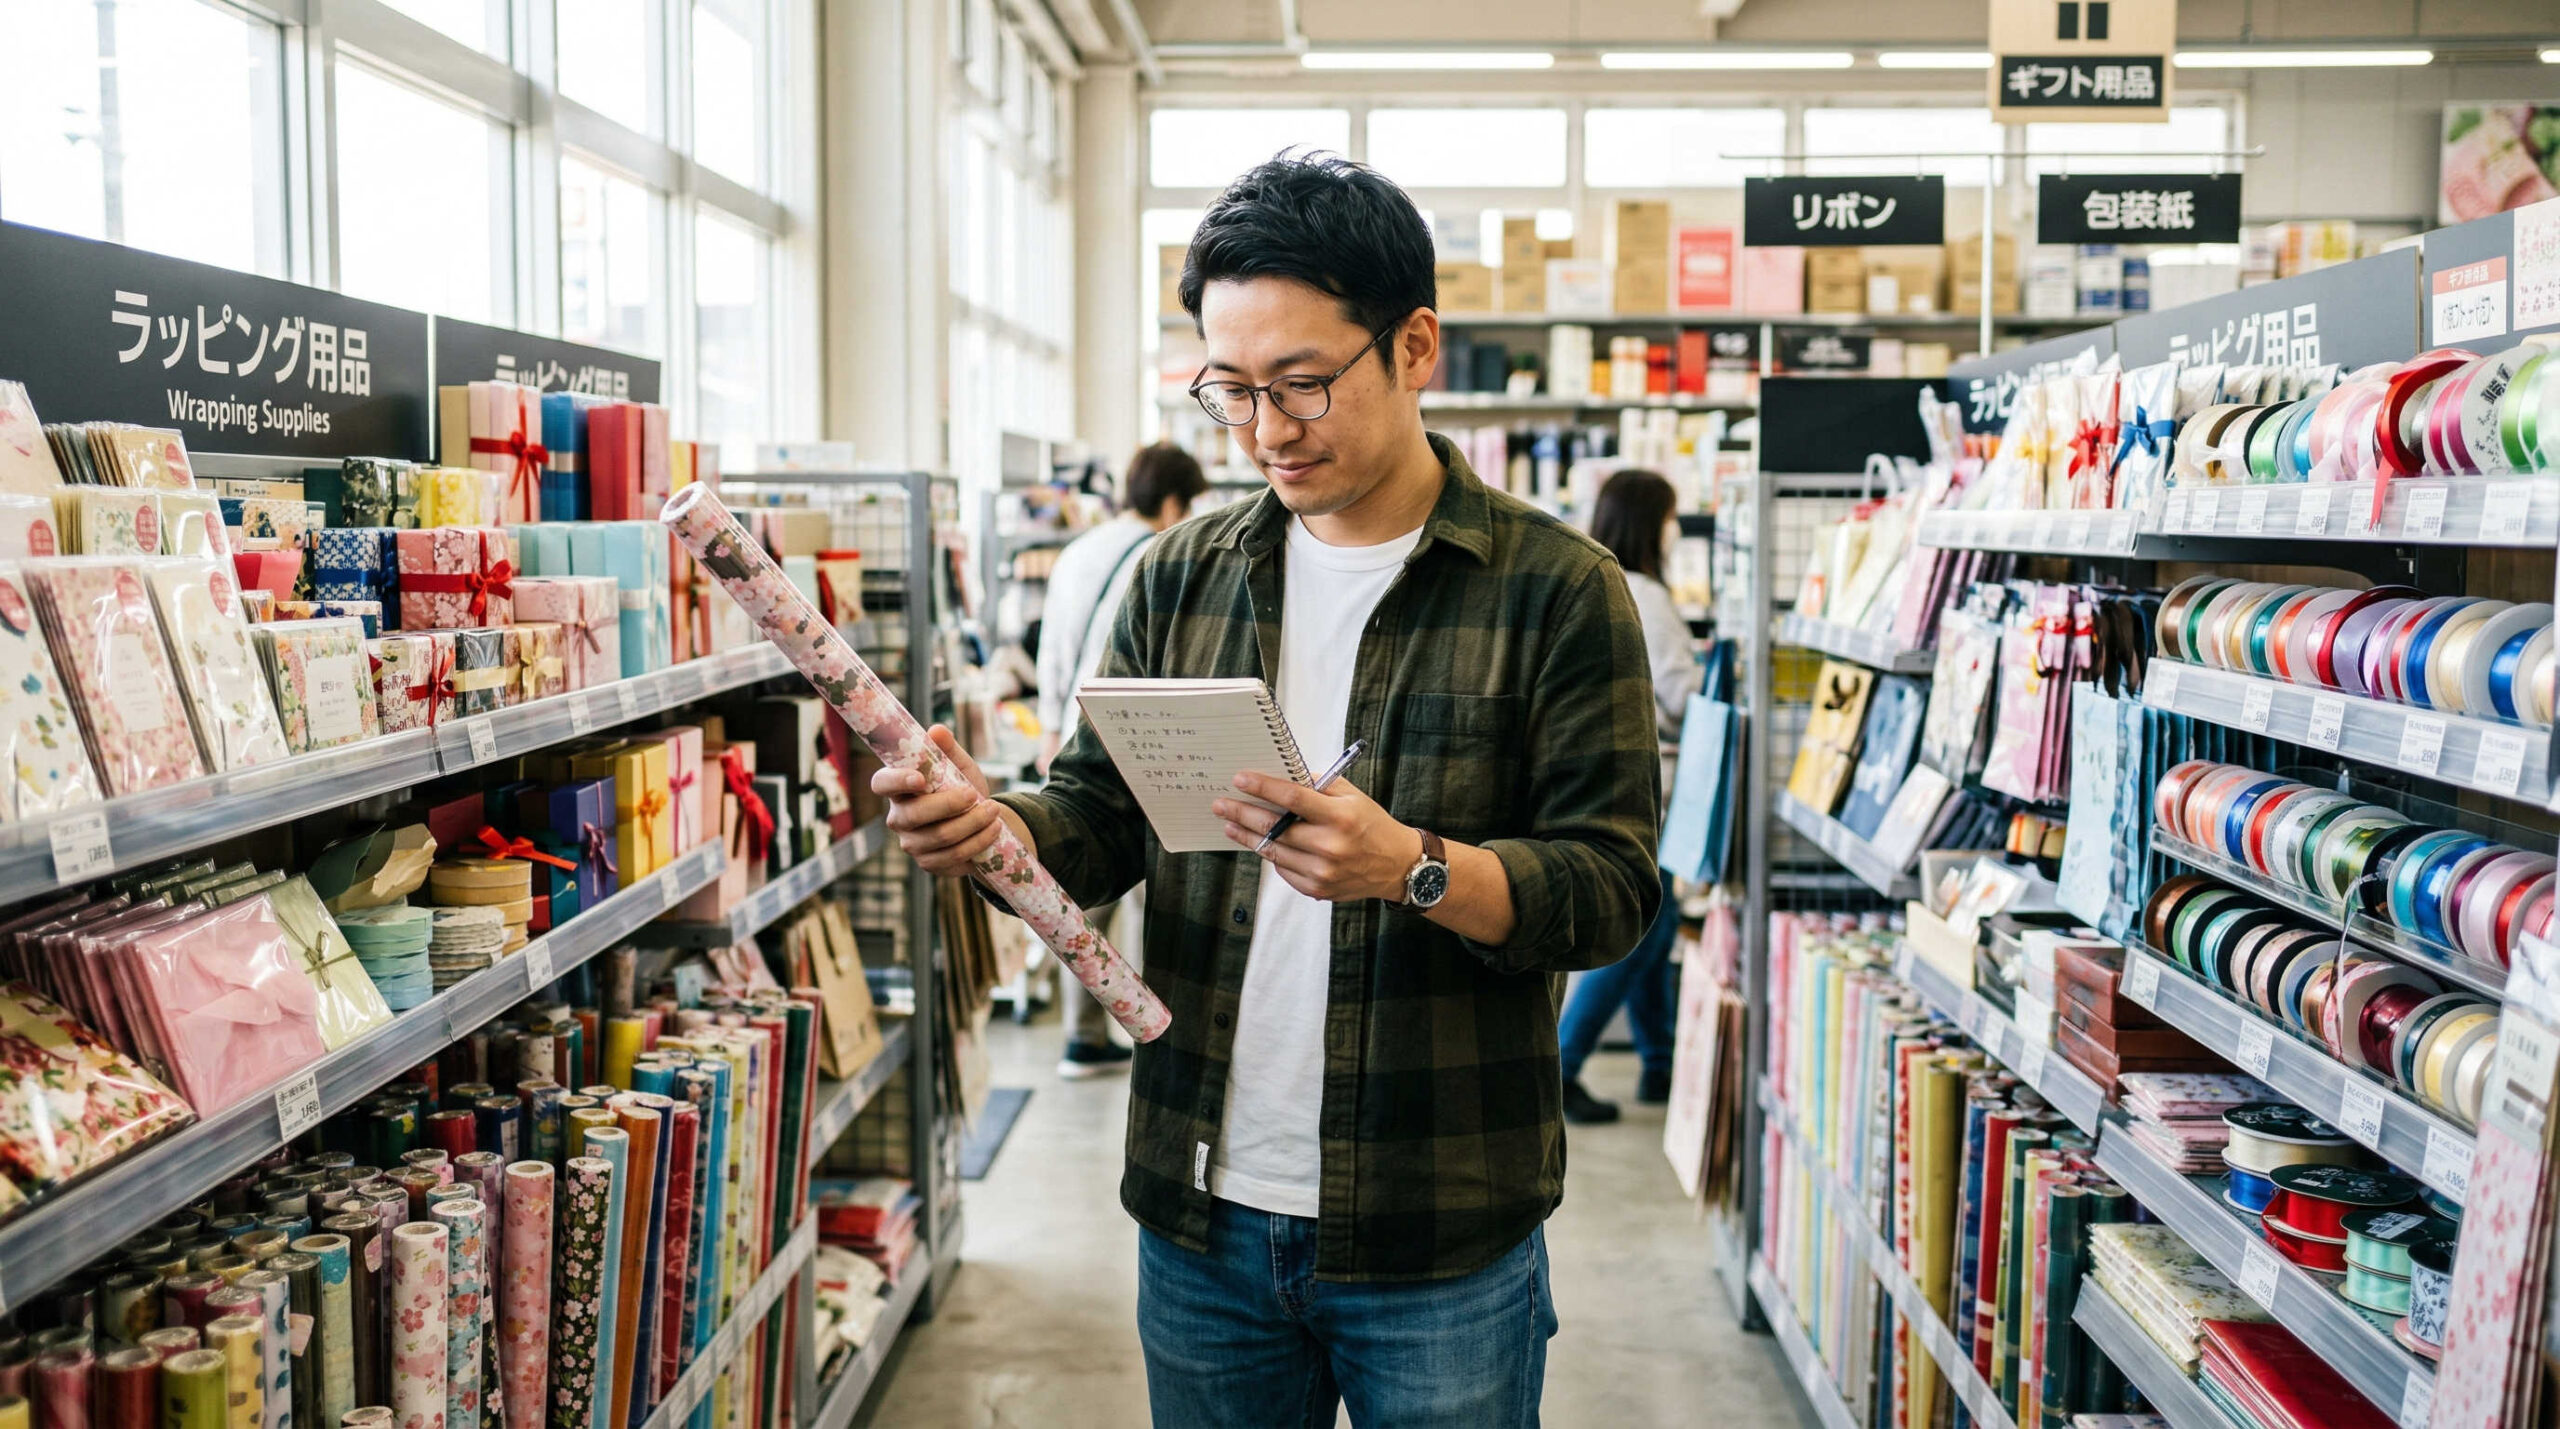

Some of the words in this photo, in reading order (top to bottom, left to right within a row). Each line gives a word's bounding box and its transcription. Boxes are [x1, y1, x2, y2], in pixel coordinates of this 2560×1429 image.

[2008, 65, 2155, 99] ギフト用品
[1793, 190, 1896, 230] リボン
[2082, 190, 2194, 230] 包装紙
[111, 289, 371, 397] ラッピング用品
[167, 389, 257, 434] Wrapping
[262, 400, 331, 437] Supplies
